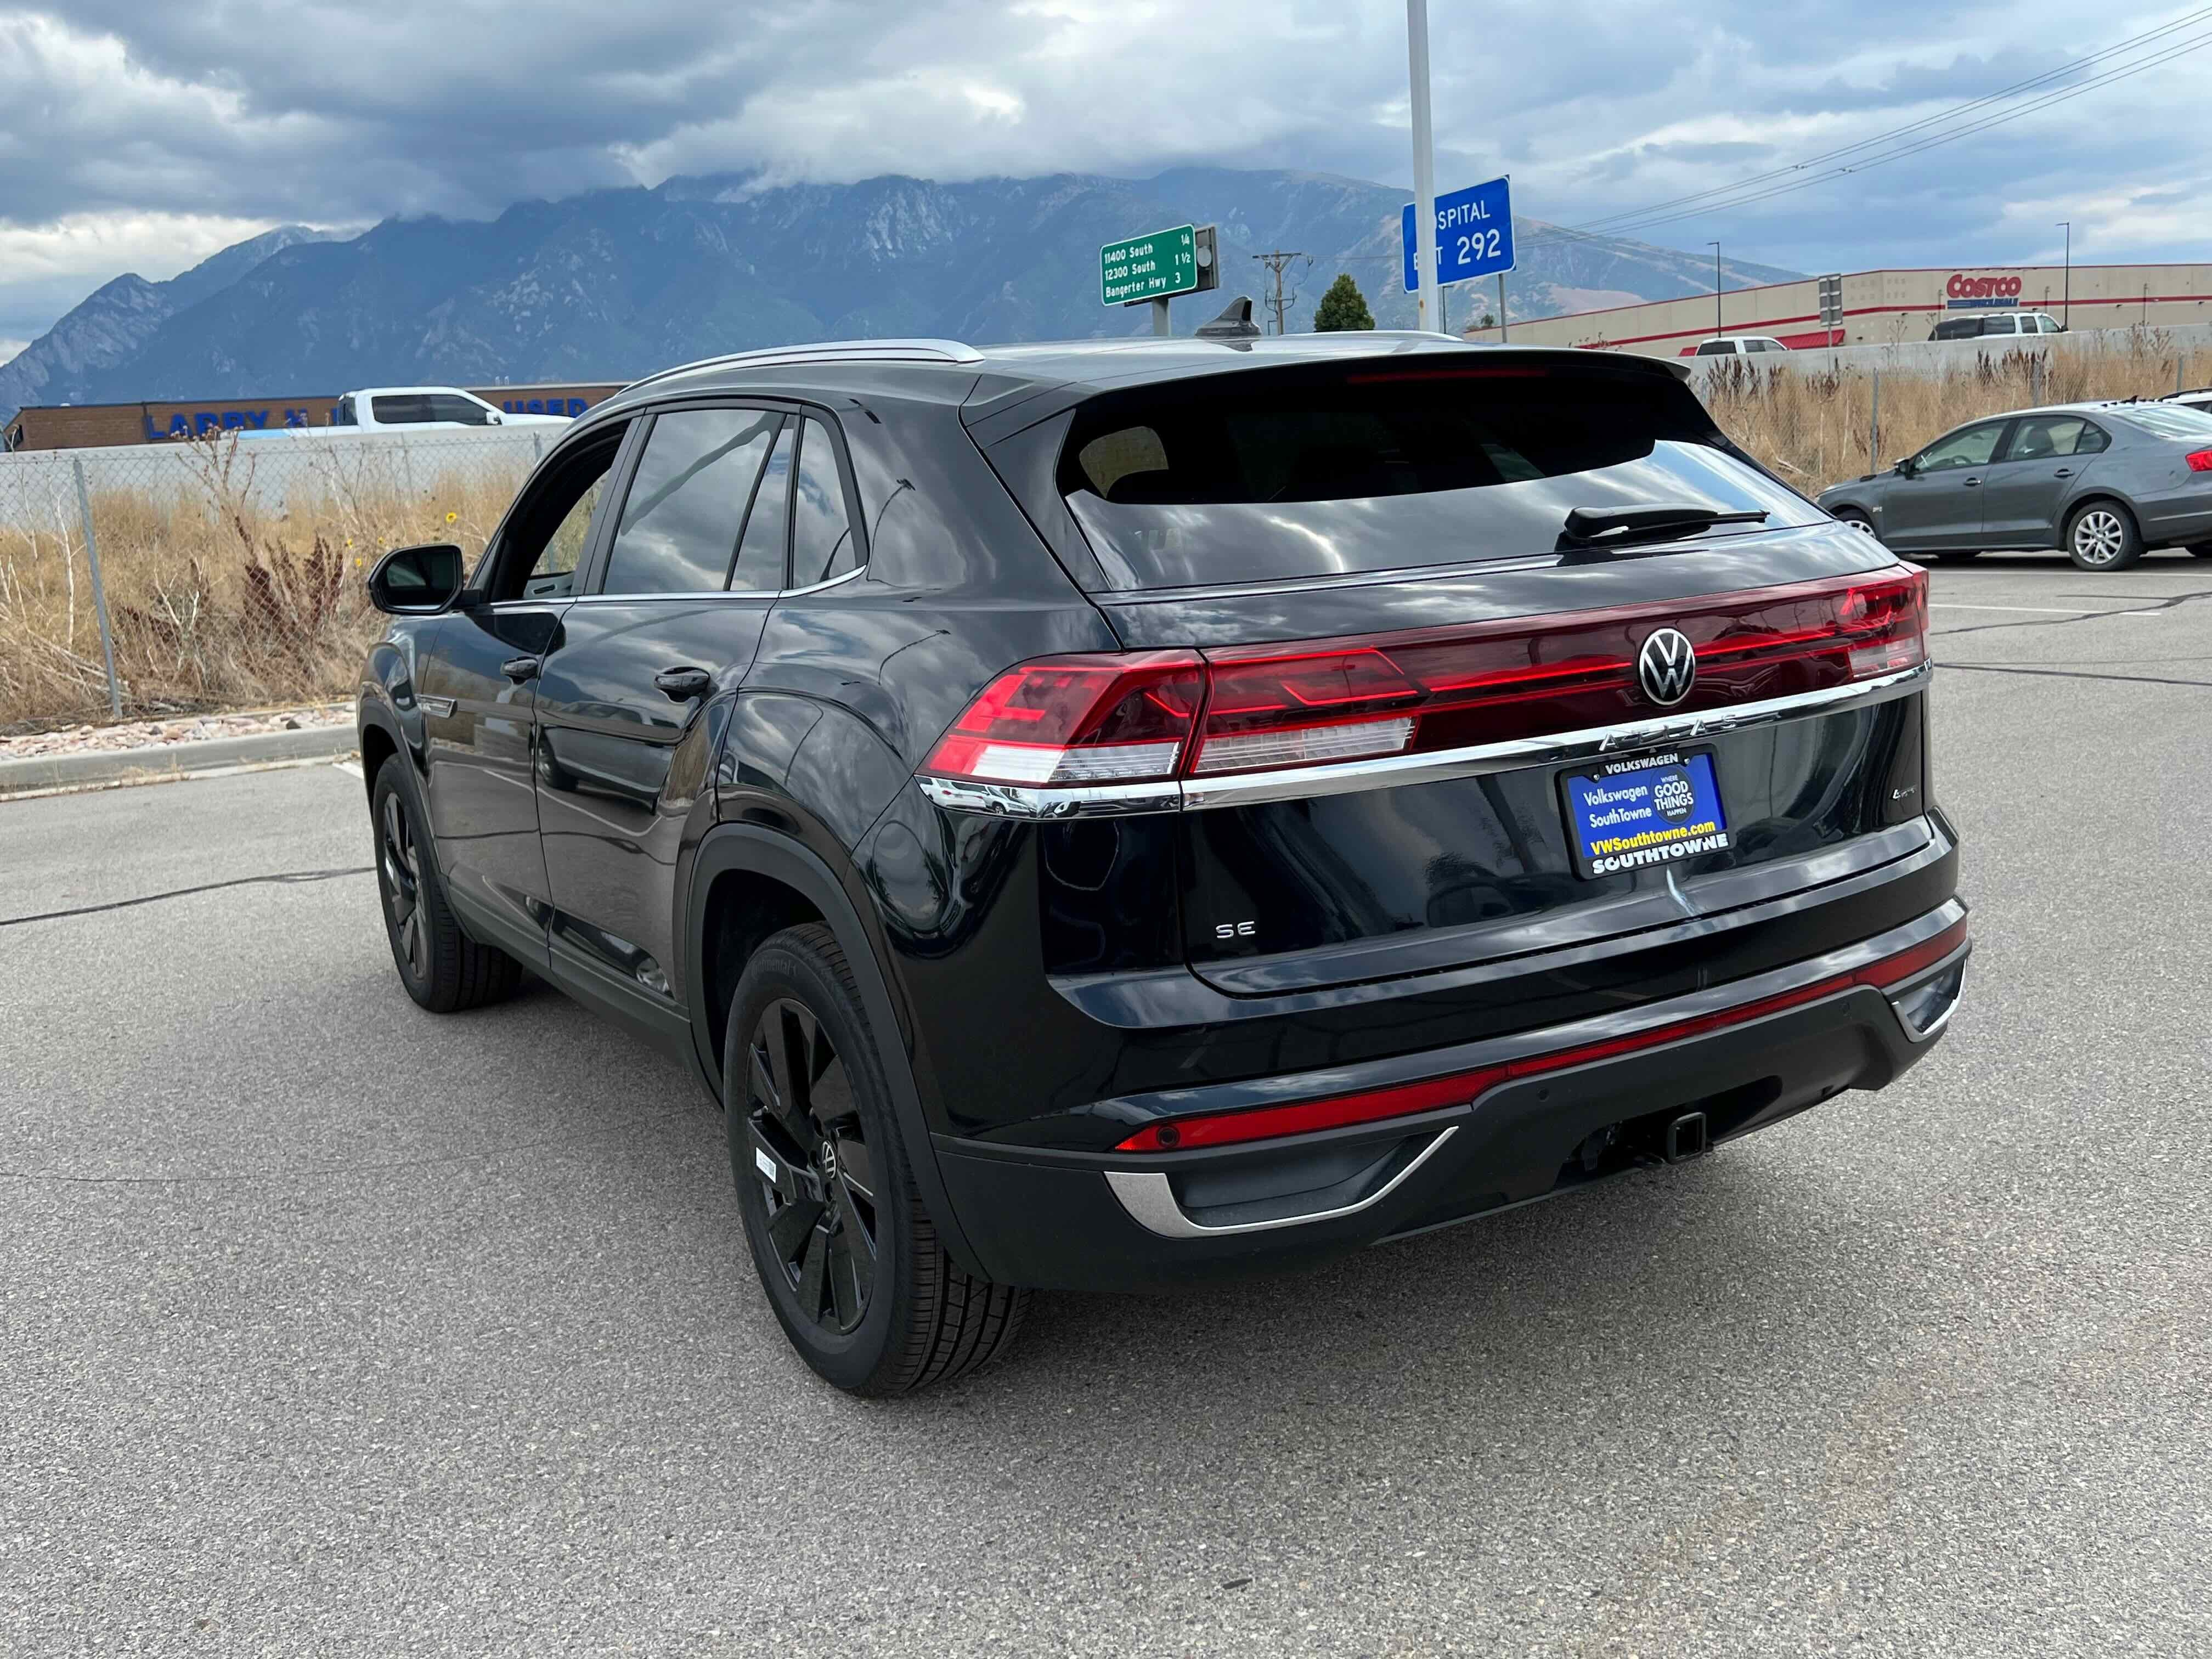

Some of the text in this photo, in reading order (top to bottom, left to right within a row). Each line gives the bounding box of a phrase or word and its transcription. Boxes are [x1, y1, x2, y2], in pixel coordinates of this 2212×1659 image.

[1435, 200, 1491, 230] SPITAL
[1104, 249, 1126, 264] 11400
[1129, 242, 1153, 258] South
[1457, 228, 1502, 265] 292
[1105, 266, 1128, 281] 12300
[1132, 259, 1156, 275] South
[1105, 272, 1181, 298] Bangerter Hwy 3
[1946, 273, 2022, 298] COSTCO
[1598, 714, 1738, 751] ATLAS
[1605, 753, 1679, 775] VOLKSWAGEN
[1654, 780, 1689, 798] GOOD
[1661, 774, 1679, 783] WHERE
[1583, 785, 1649, 806] Volkswagen
[1654, 792, 1694, 811] THINGS
[1589, 806, 1652, 828] SouthTowne
[1666, 807, 1687, 817] HAPPEN
[1590, 821, 1716, 856] VWSouthtowne.com
[1592, 833, 1729, 874] SOUTHTOWNE
[1215, 921, 1256, 939] SE
